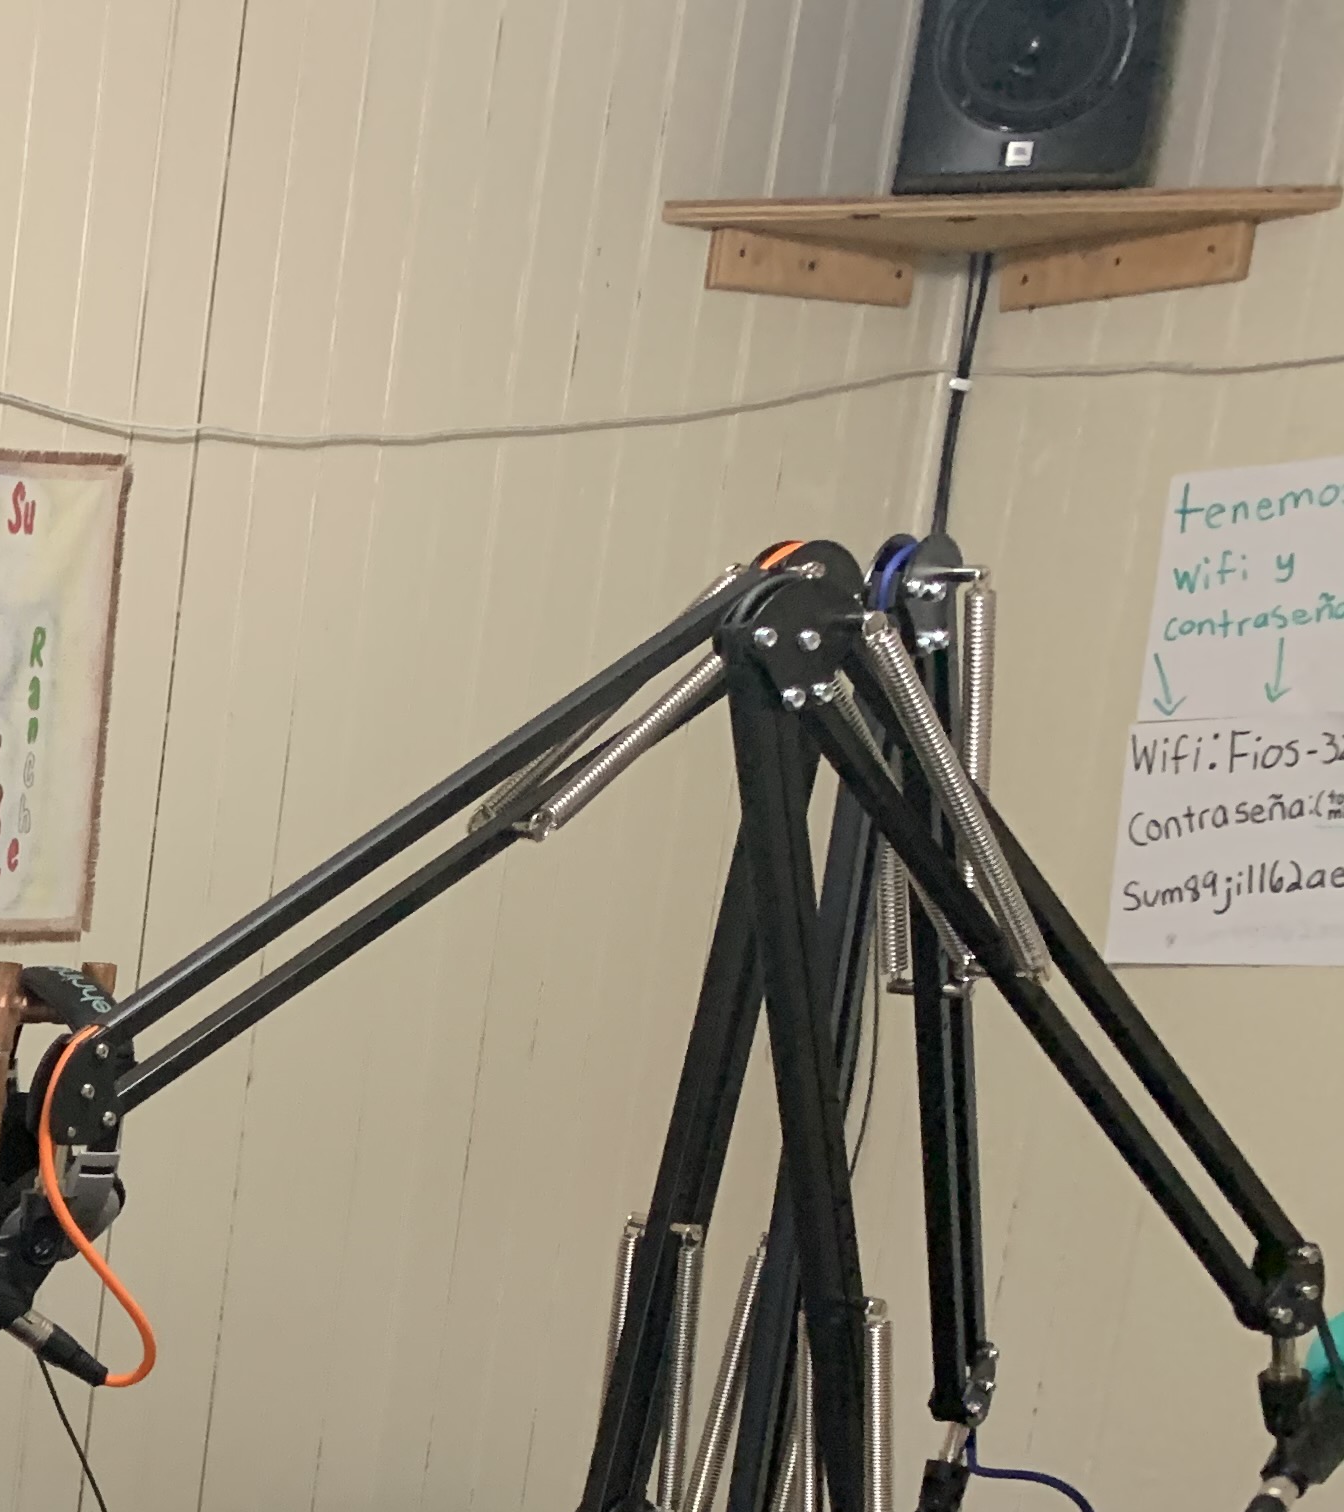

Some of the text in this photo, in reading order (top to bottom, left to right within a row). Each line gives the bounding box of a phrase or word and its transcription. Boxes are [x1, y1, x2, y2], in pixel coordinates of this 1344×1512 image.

[8, 480, 36, 535] Su
[1174, 483, 1344, 534] tenemo
[1173, 550, 1295, 594] wifi y
